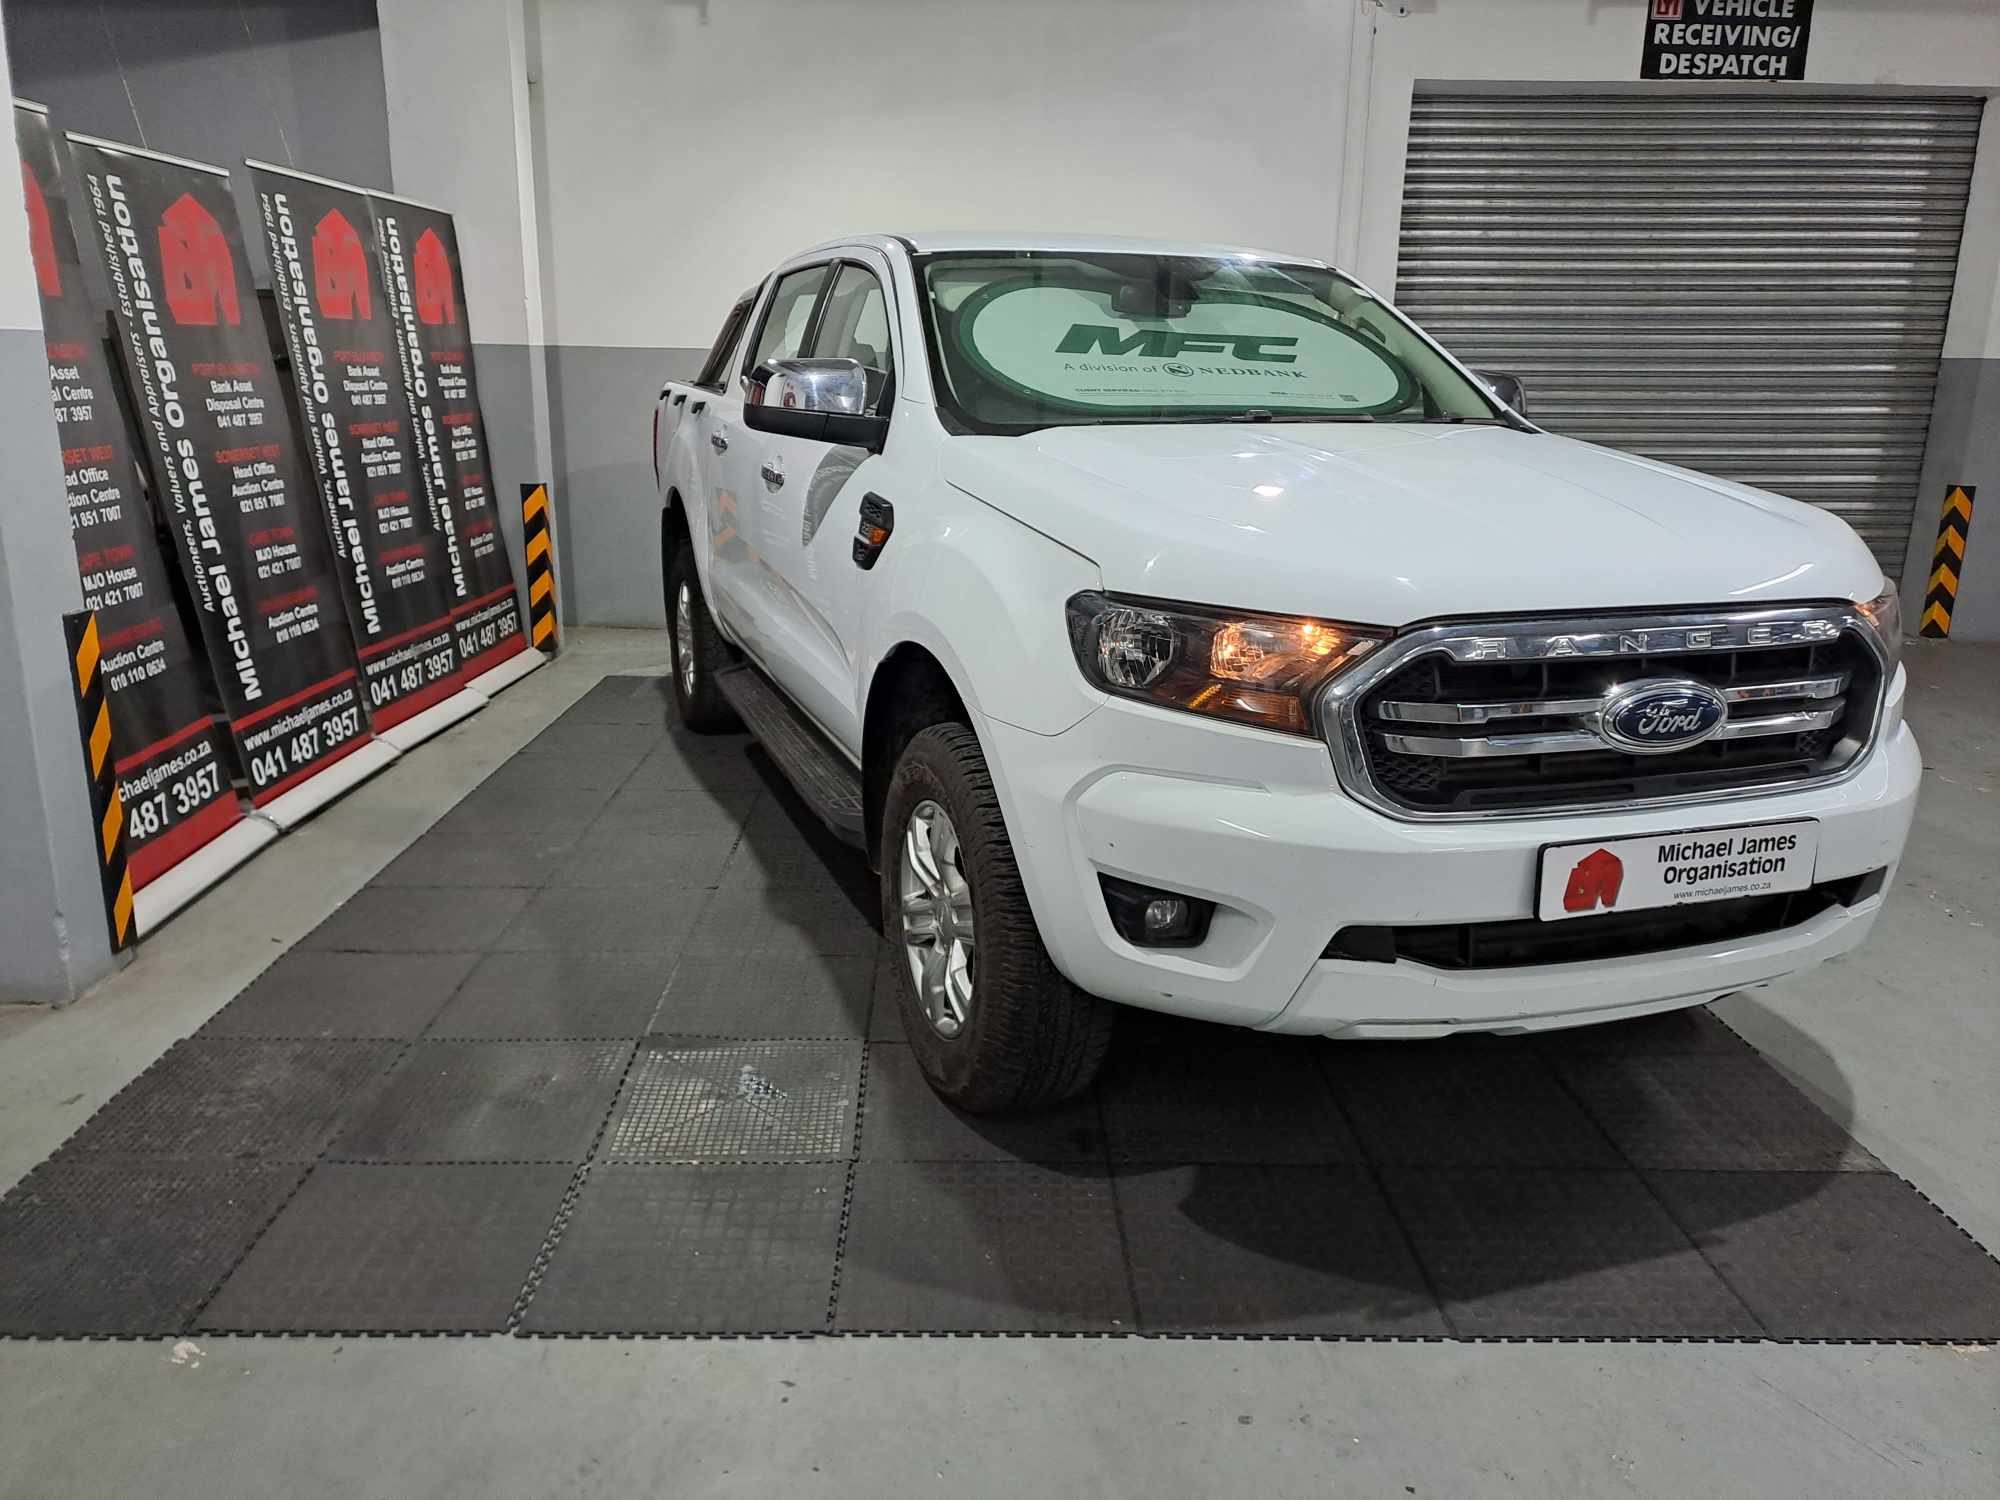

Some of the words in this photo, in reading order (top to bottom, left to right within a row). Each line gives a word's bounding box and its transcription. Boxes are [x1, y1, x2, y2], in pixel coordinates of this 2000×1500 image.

[1695, 0, 1795, 18] VEHICLE
[1653, 23, 1802, 49] RECEIVING/
[1658, 53, 1788, 76] DESPATCH
[87, 173, 107, 216] 1964
[98, 220, 134, 317] Established
[268, 230, 292, 311] Established
[105, 174, 185, 429] Organisation
[274, 193, 329, 404] Organisation
[386, 217, 427, 398] Organisation
[288, 322, 311, 394] Appraisers
[1055, 323, 1299, 363] MFC
[50, 365, 80, 380] Asset
[130, 331, 161, 418] Appraisers
[1064, 362, 1075, 371] A
[1079, 362, 1138, 373] division
[1143, 364, 1159, 373] of
[1199, 366, 1309, 379] NEDBANK
[54, 406, 68, 422] 87
[70, 405, 93, 421] 3957
[62, 386, 94, 401] Centre
[302, 394, 317, 424] and
[152, 420, 170, 452] and
[310, 426, 328, 475] Valuers
[421, 405, 446, 491] James
[65, 469, 79, 486] ad
[79, 467, 109, 484] Office
[321, 413, 354, 511] James
[67, 491, 90, 508] tion
[90, 486, 121, 503] Centre
[164, 455, 187, 514] Valuers
[176, 438, 223, 555] James
[80, 509, 99, 527] 851
[99, 505, 122, 523] 7007
[437, 497, 467, 597] Michael
[82, 572, 105, 592] MJO
[105, 566, 138, 585] House
[85, 594, 104, 611] 021
[104, 589, 123, 606] 421
[122, 581, 144, 601] 7007
[342, 518, 381, 635] Michael
[208, 564, 263, 701] Michael
[459, 631, 480, 658] 041
[480, 622, 496, 647] 487
[497, 611, 519, 638] 3957
[1473, 619, 1842, 660] RANGER
[100, 652, 136, 675] Auction
[136, 640, 165, 659] Centre
[127, 665, 147, 684] 110
[370, 674, 398, 706] 041
[400, 661, 423, 692] 487
[425, 647, 454, 680] 3957
[243, 688, 354, 752] www.michaeljames.co.za
[1637, 701, 1704, 737] Ford
[251, 746, 288, 786] 041
[290, 727, 320, 763] 487
[321, 706, 359, 746] 3957
[118, 740, 213, 803] chaeljames.co.za
[129, 791, 169, 839] 487
[172, 760, 220, 814] 3957
[1657, 837, 1734, 863] Michael
[1737, 834, 1797, 855] James
[1663, 856, 1786, 885] Organisation
[1673, 881, 1772, 900] www.michaeljames.co.za
